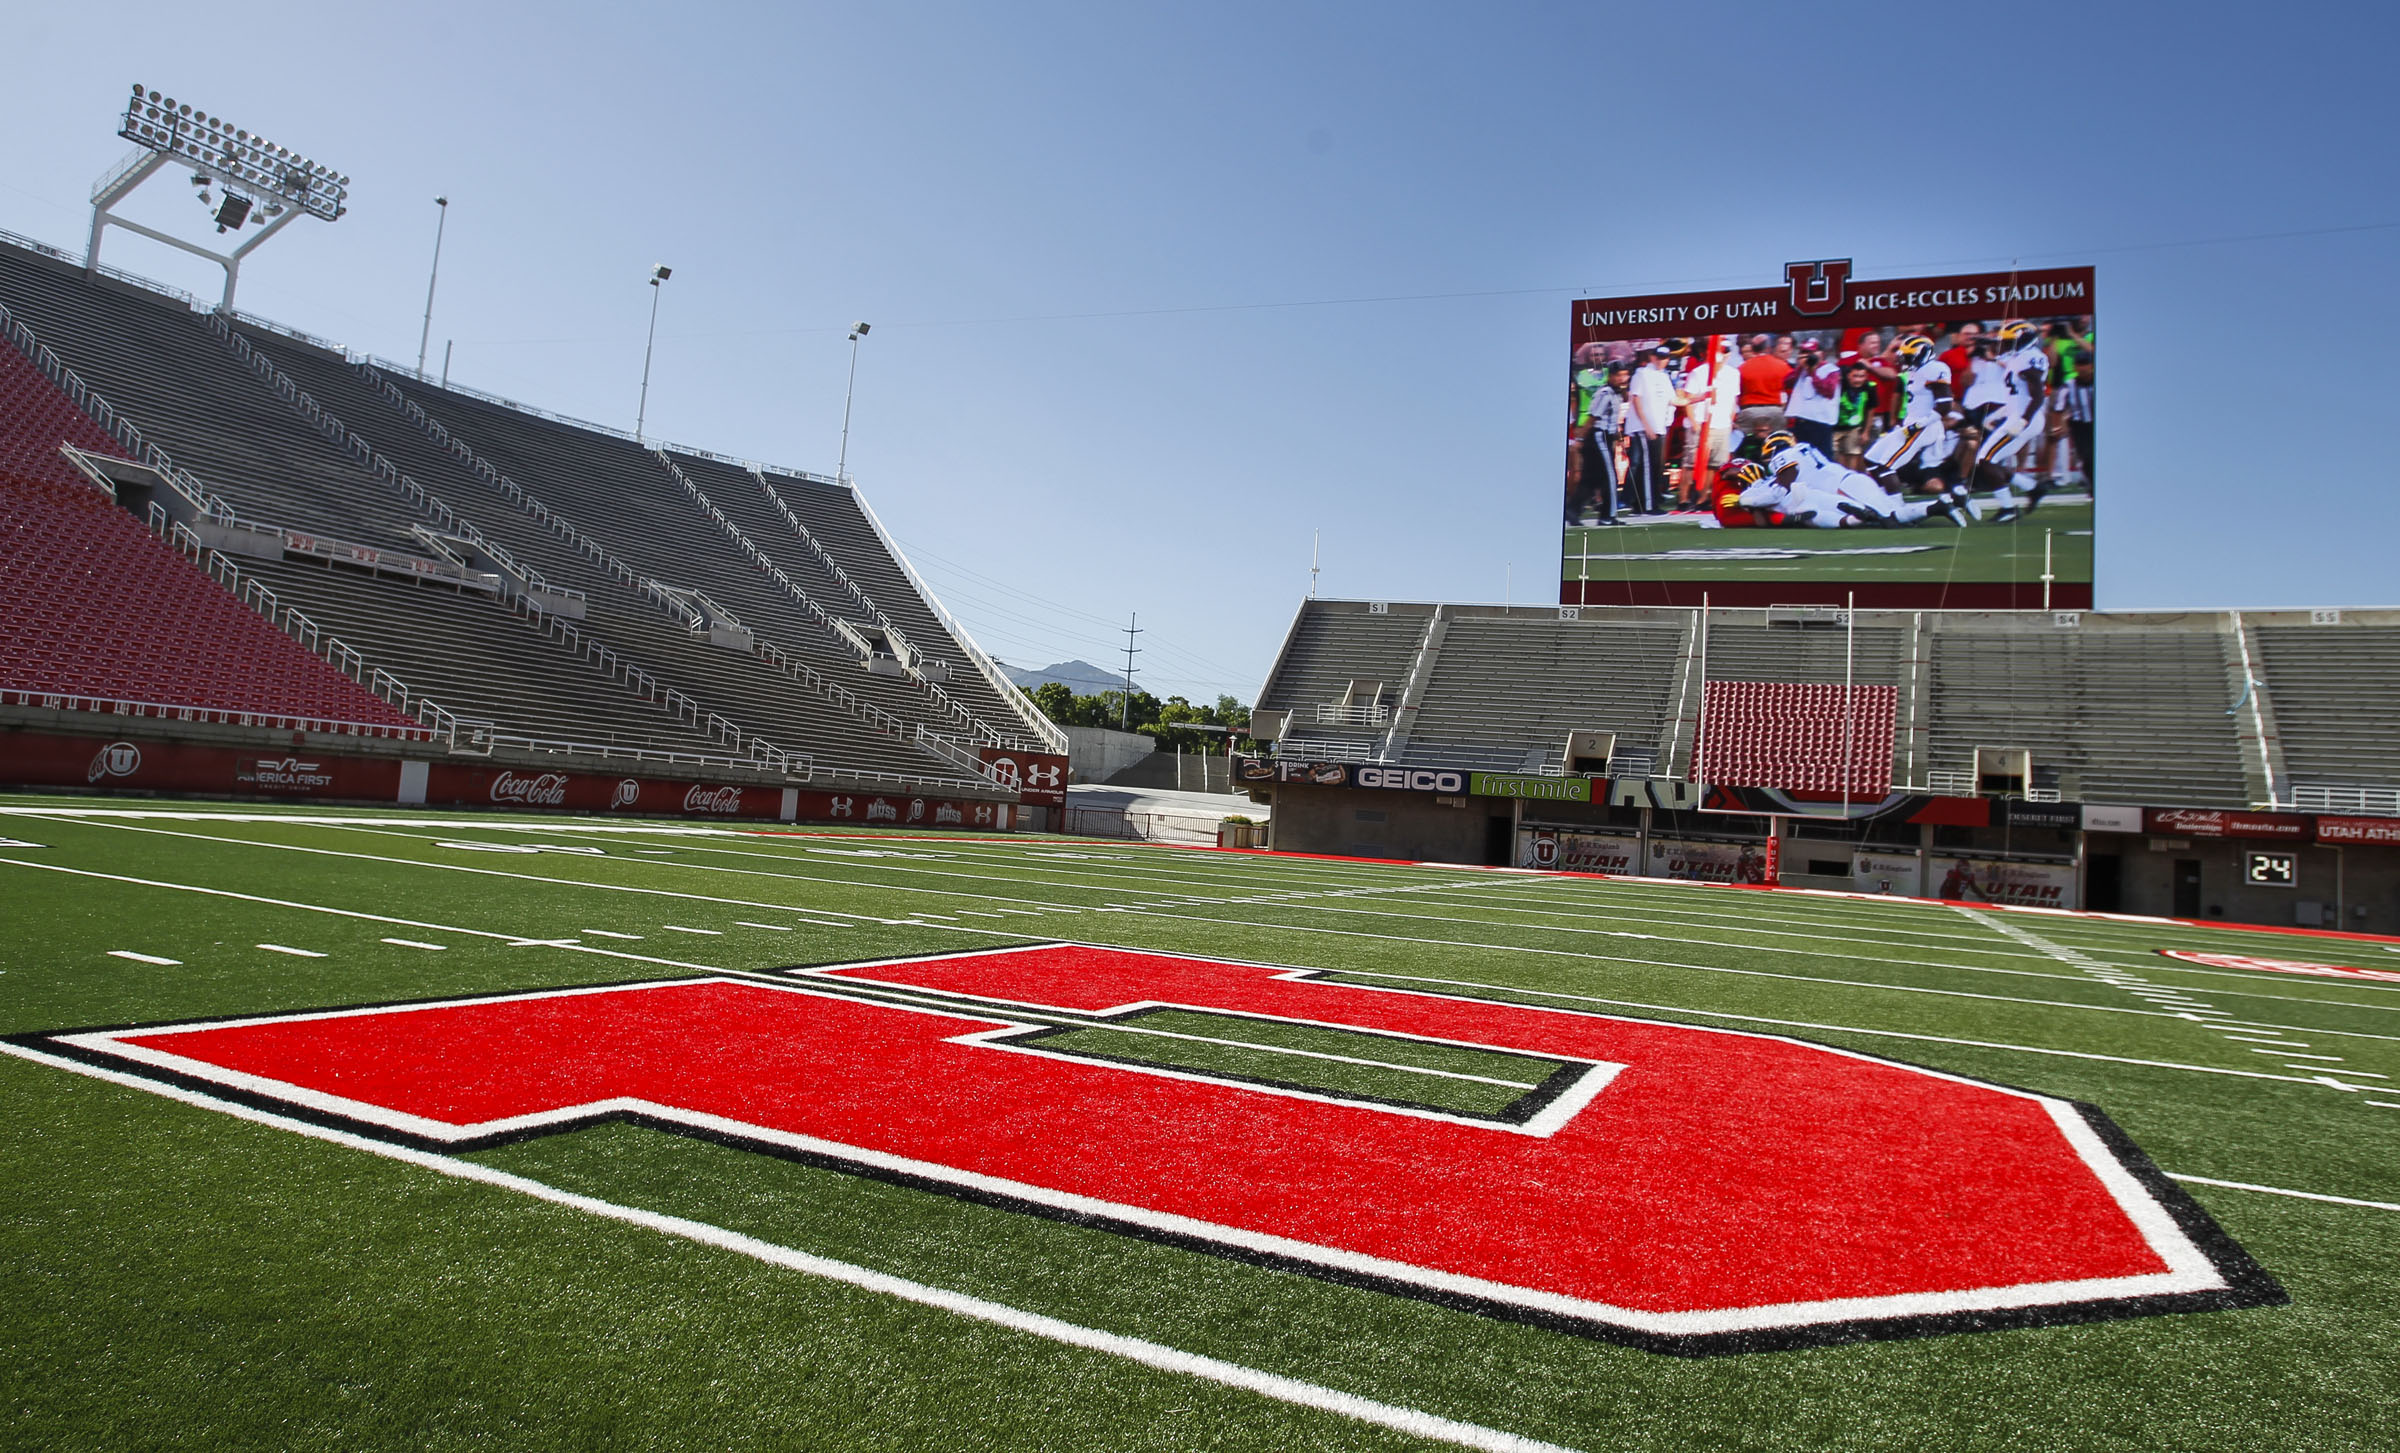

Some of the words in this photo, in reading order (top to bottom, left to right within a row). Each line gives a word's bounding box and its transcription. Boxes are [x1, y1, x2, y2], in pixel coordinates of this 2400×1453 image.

[1785, 257, 1852, 316] U
[1855, 288, 1979, 311] RICE-ECCLES
[1985, 282, 2085, 304] STADIUM
[1582, 307, 1688, 327] UNIVERSITY
[1694, 305, 1719, 320] OF
[1726, 301, 1777, 318] UTAH
[1562, 609, 1576, 620] S2
[1588, 740, 1597, 750] 2
[111, 748, 135, 772] U
[297, 774, 333, 786] FIRST
[490, 770, 568, 805] Coca-Cola
[1358, 767, 1462, 793] GEICO
[1481, 774, 1527, 797] first
[1533, 779, 1582, 800] mile
[622, 783, 636, 800] U
[683, 784, 743, 814] Coca-Cola
[866, 800, 897, 821] MUSS
[935, 806, 962, 823] MUSS
[2319, 826, 2363, 839] UTAH
[1537, 843, 1555, 862] U
[1565, 853, 1630, 869] UTAH
[1769, 849, 1777, 877] UTAH
[1668, 859, 1736, 876] UTAH
[2252, 856, 2290, 880] 24
[1986, 881, 2063, 899] UTAH
